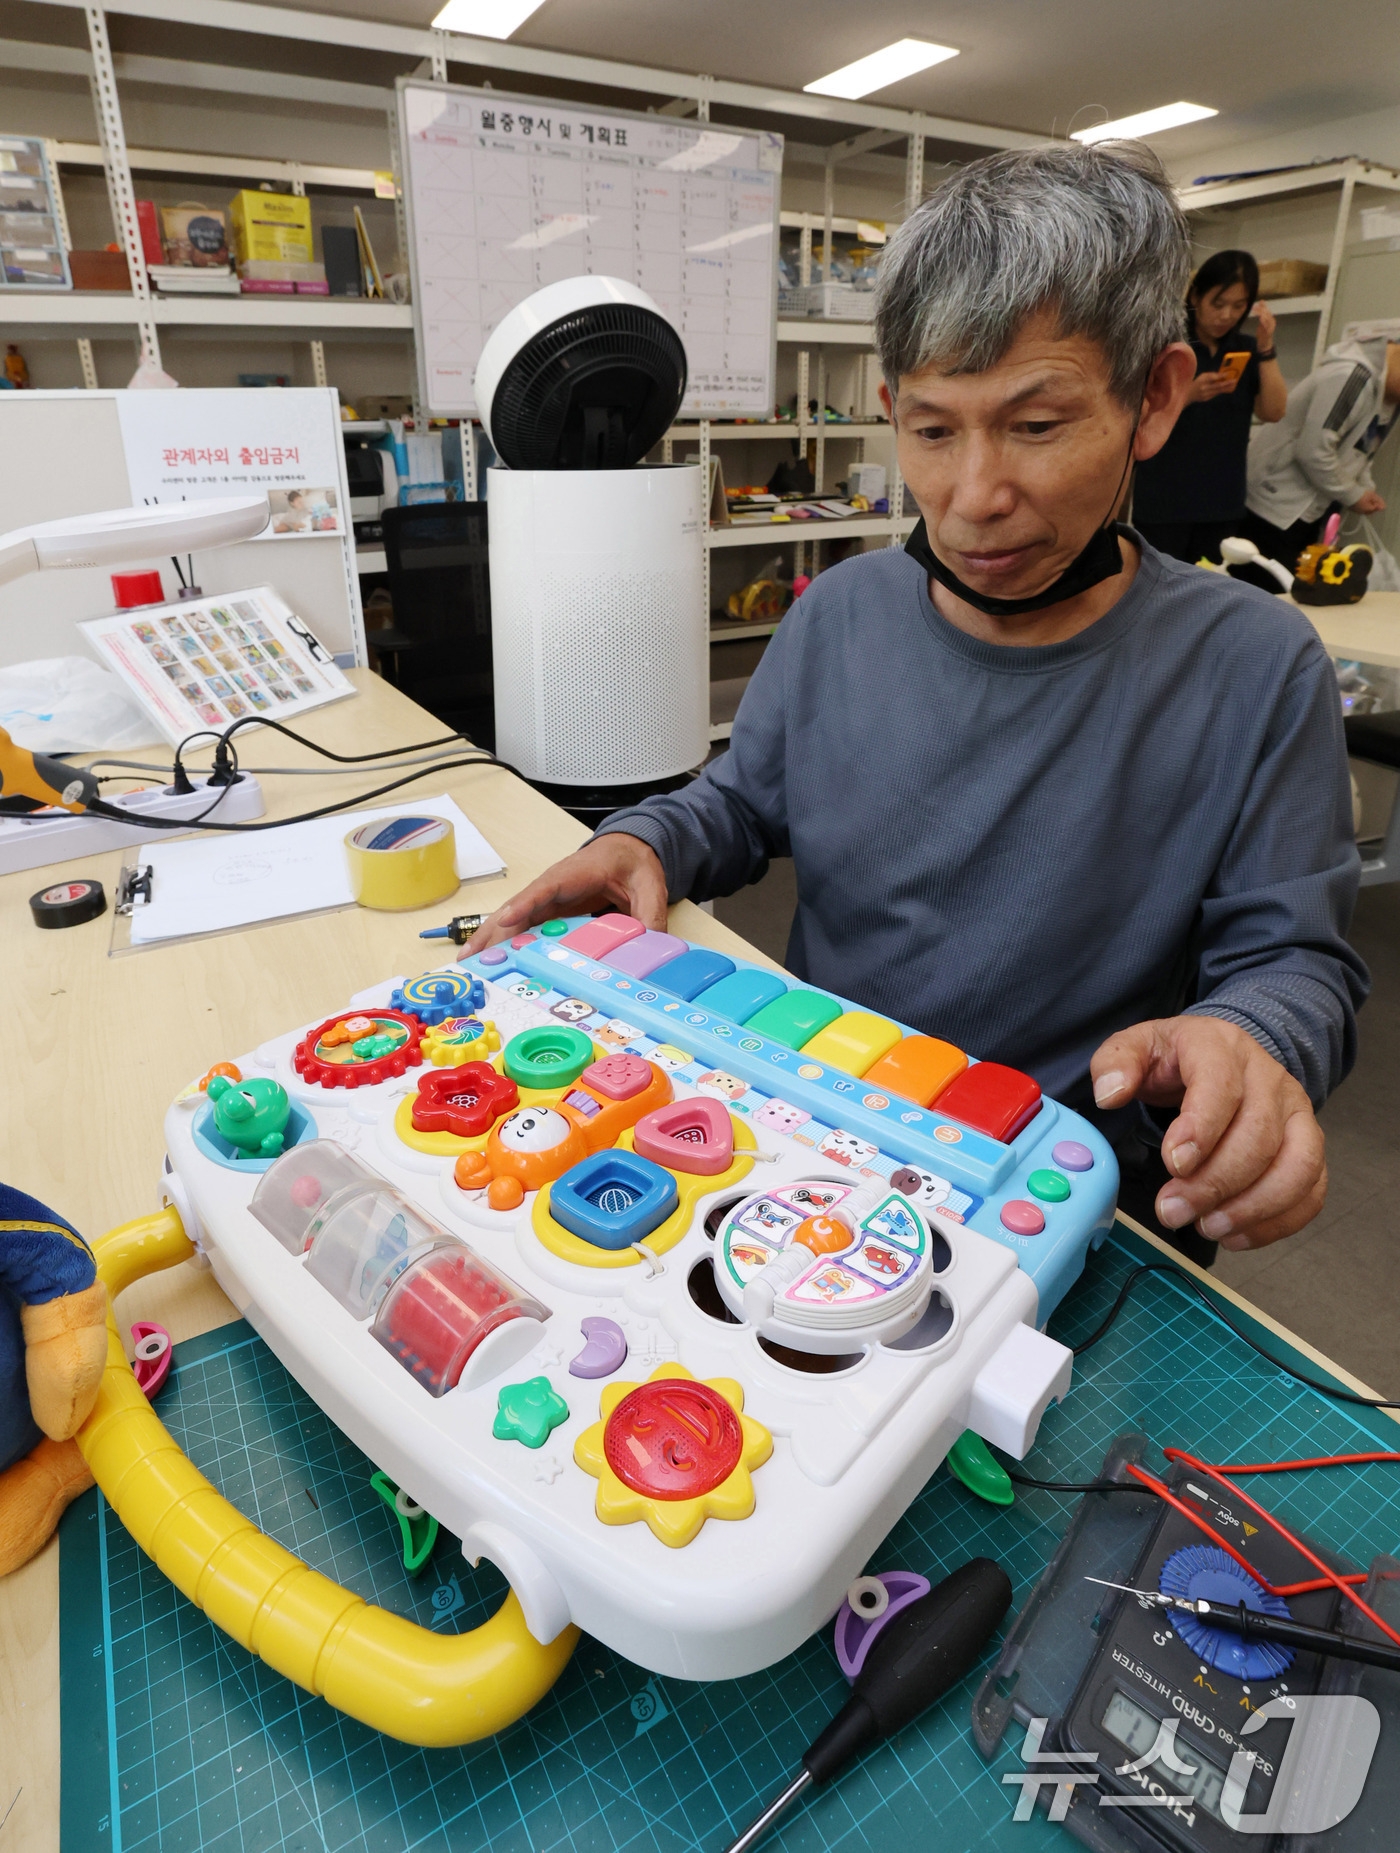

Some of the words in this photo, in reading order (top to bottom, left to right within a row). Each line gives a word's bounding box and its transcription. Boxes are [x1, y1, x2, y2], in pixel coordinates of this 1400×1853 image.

[481, 109, 552, 138] 월중행사
[559, 123, 572, 140] 및
[580, 123, 628, 147] 계획표
[162, 447, 230, 467] 관계자외
[238, 446, 300, 466] 출입금지
[996, 1226, 1029, 1248] 피아노
[1217, 1510, 1240, 1527] 500V
[92, 1644, 103, 1658] 10
[633, 1696, 652, 1717] A5
[1269, 1687, 1297, 1710] OFF
[1171, 1695, 1216, 1735] CARD
[1217, 1728, 1274, 1778] 3244-60
[1121, 1758, 1197, 1828] HIOKI
[97, 1813, 110, 1832] 15
